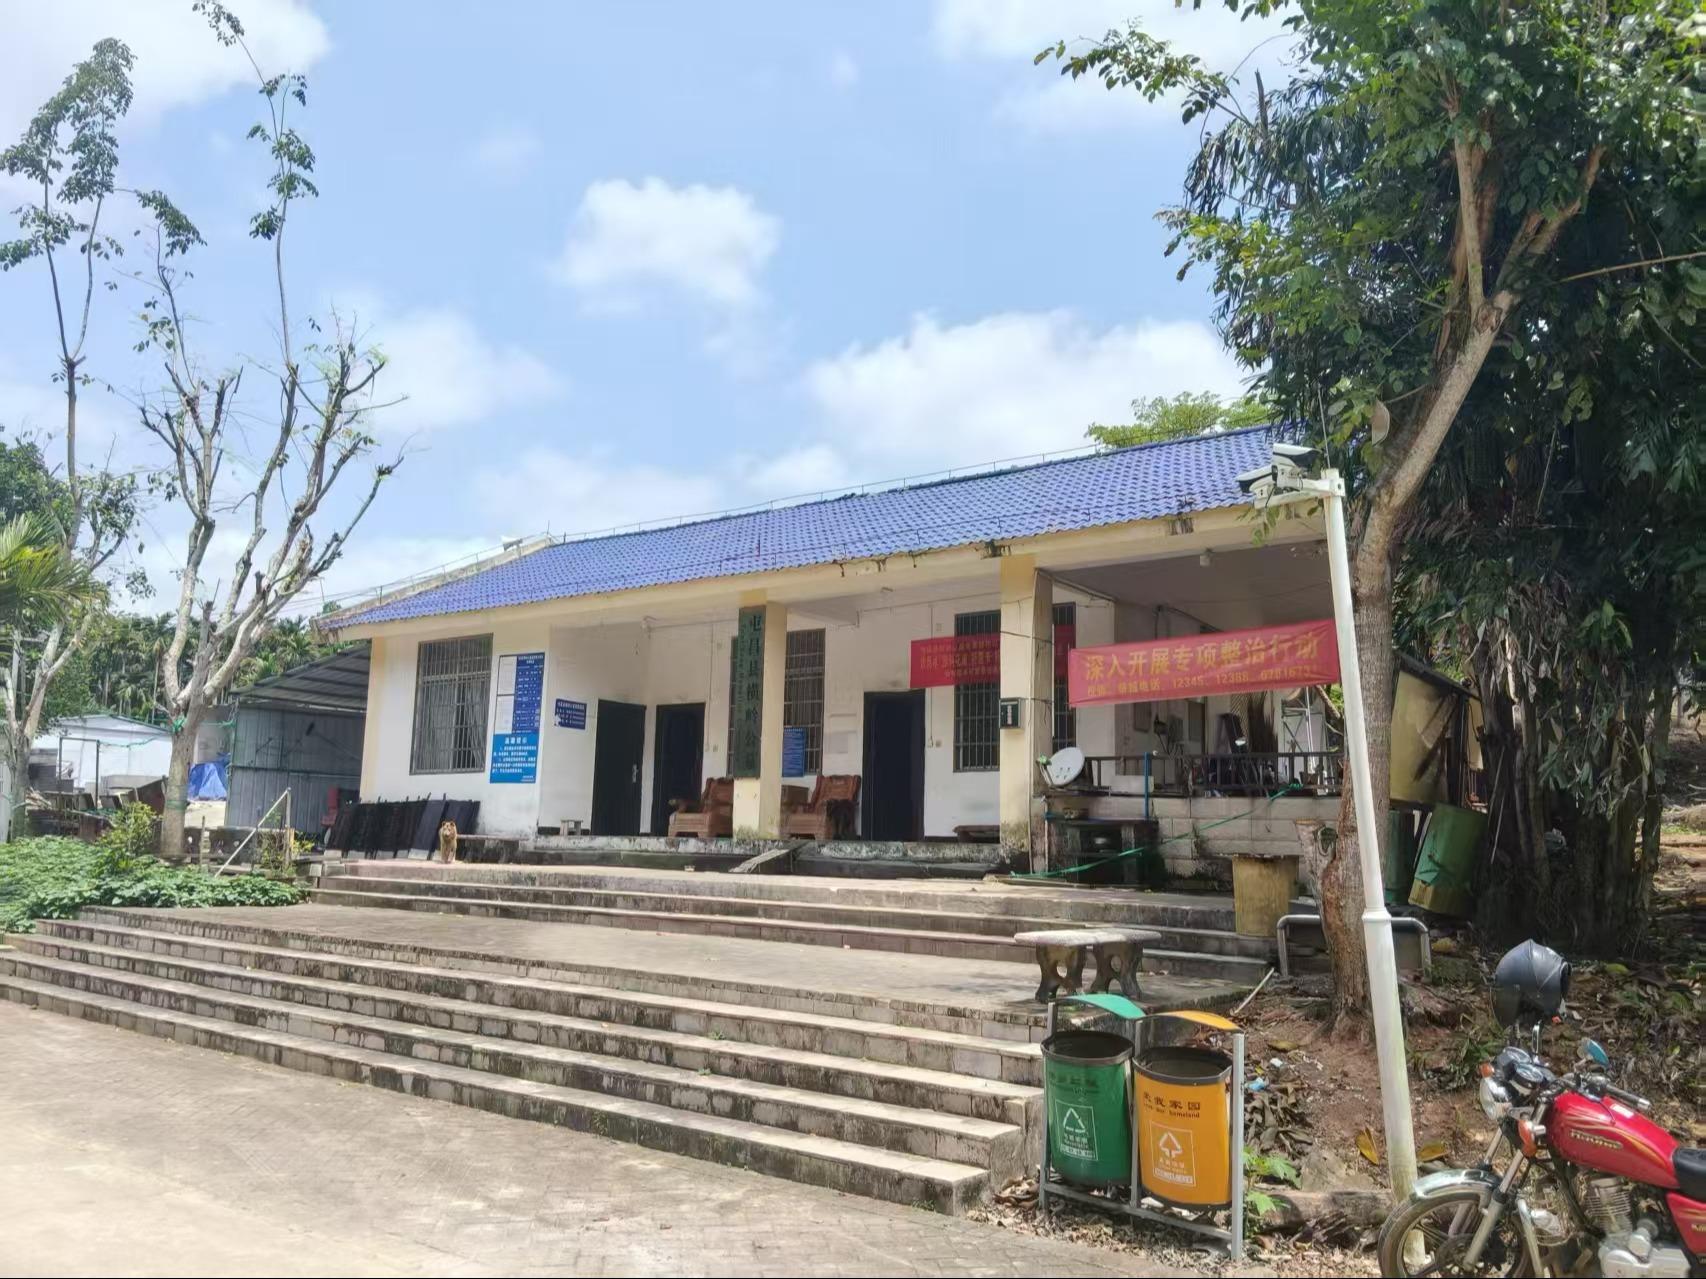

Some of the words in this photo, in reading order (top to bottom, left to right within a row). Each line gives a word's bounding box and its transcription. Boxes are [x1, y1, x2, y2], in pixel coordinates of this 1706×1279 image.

[1085, 632, 1320, 681] 深入开展专项整治行动
